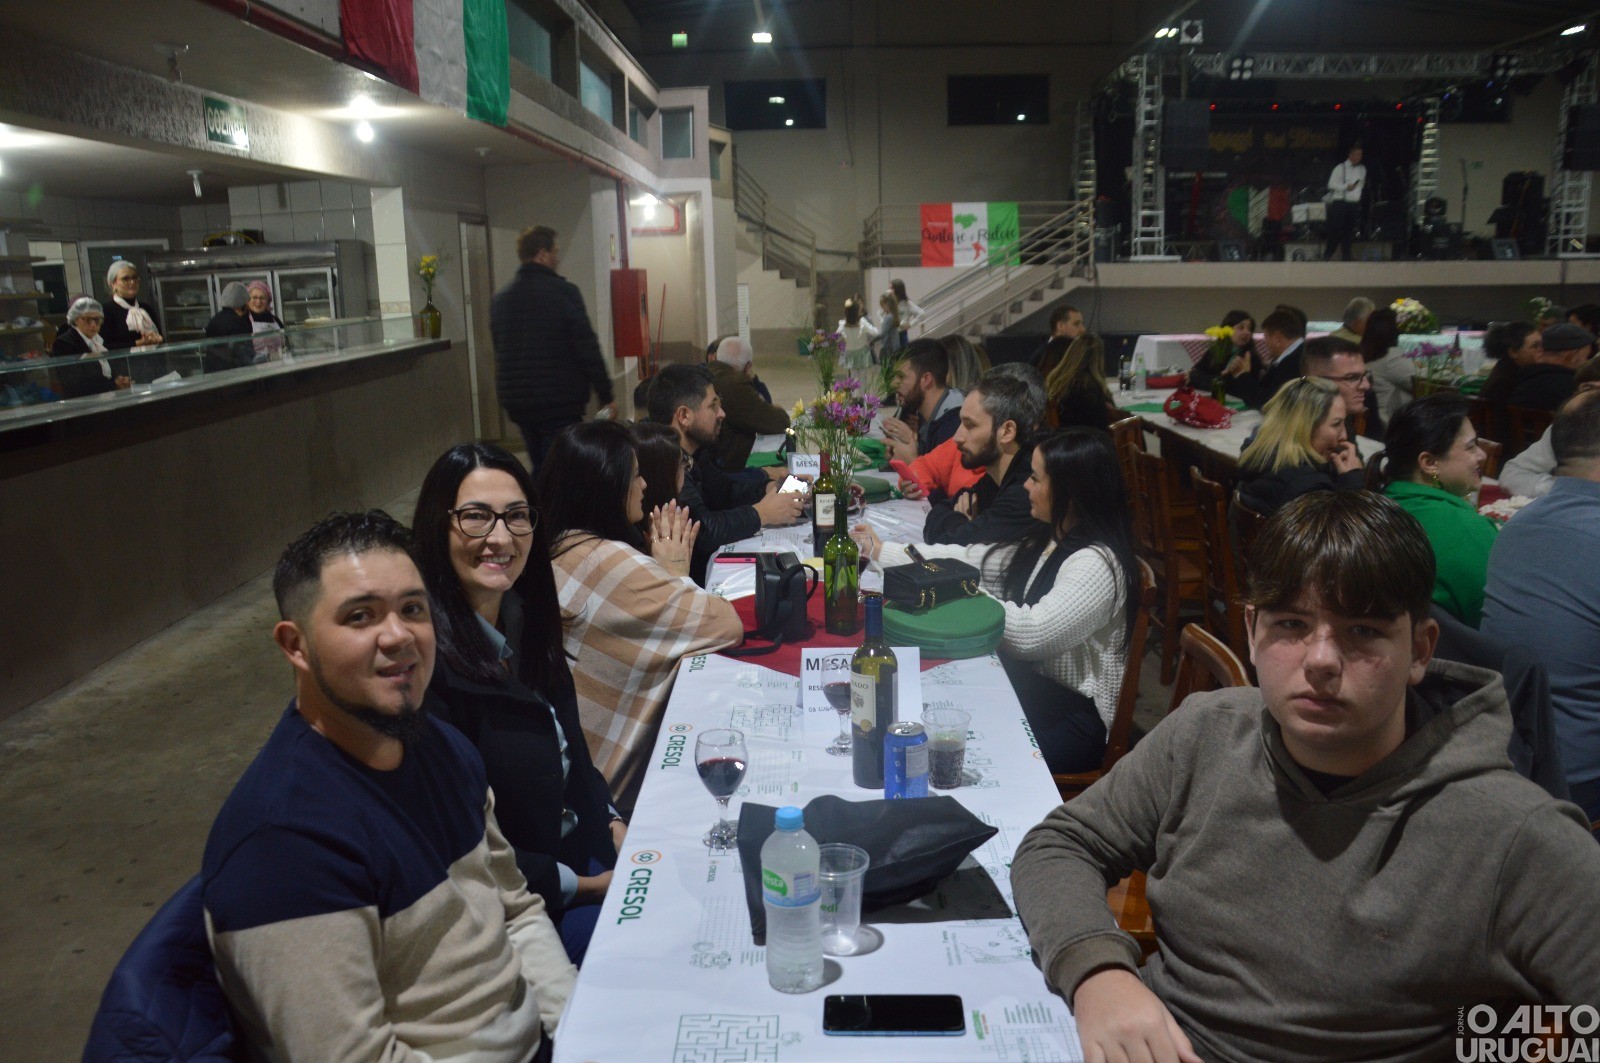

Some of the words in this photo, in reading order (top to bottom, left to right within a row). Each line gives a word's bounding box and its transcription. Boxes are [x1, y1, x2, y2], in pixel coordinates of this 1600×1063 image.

[795, 460, 819, 468] MESA
[661, 734, 687, 770] CRESOL
[616, 868, 653, 925] CRESOL
